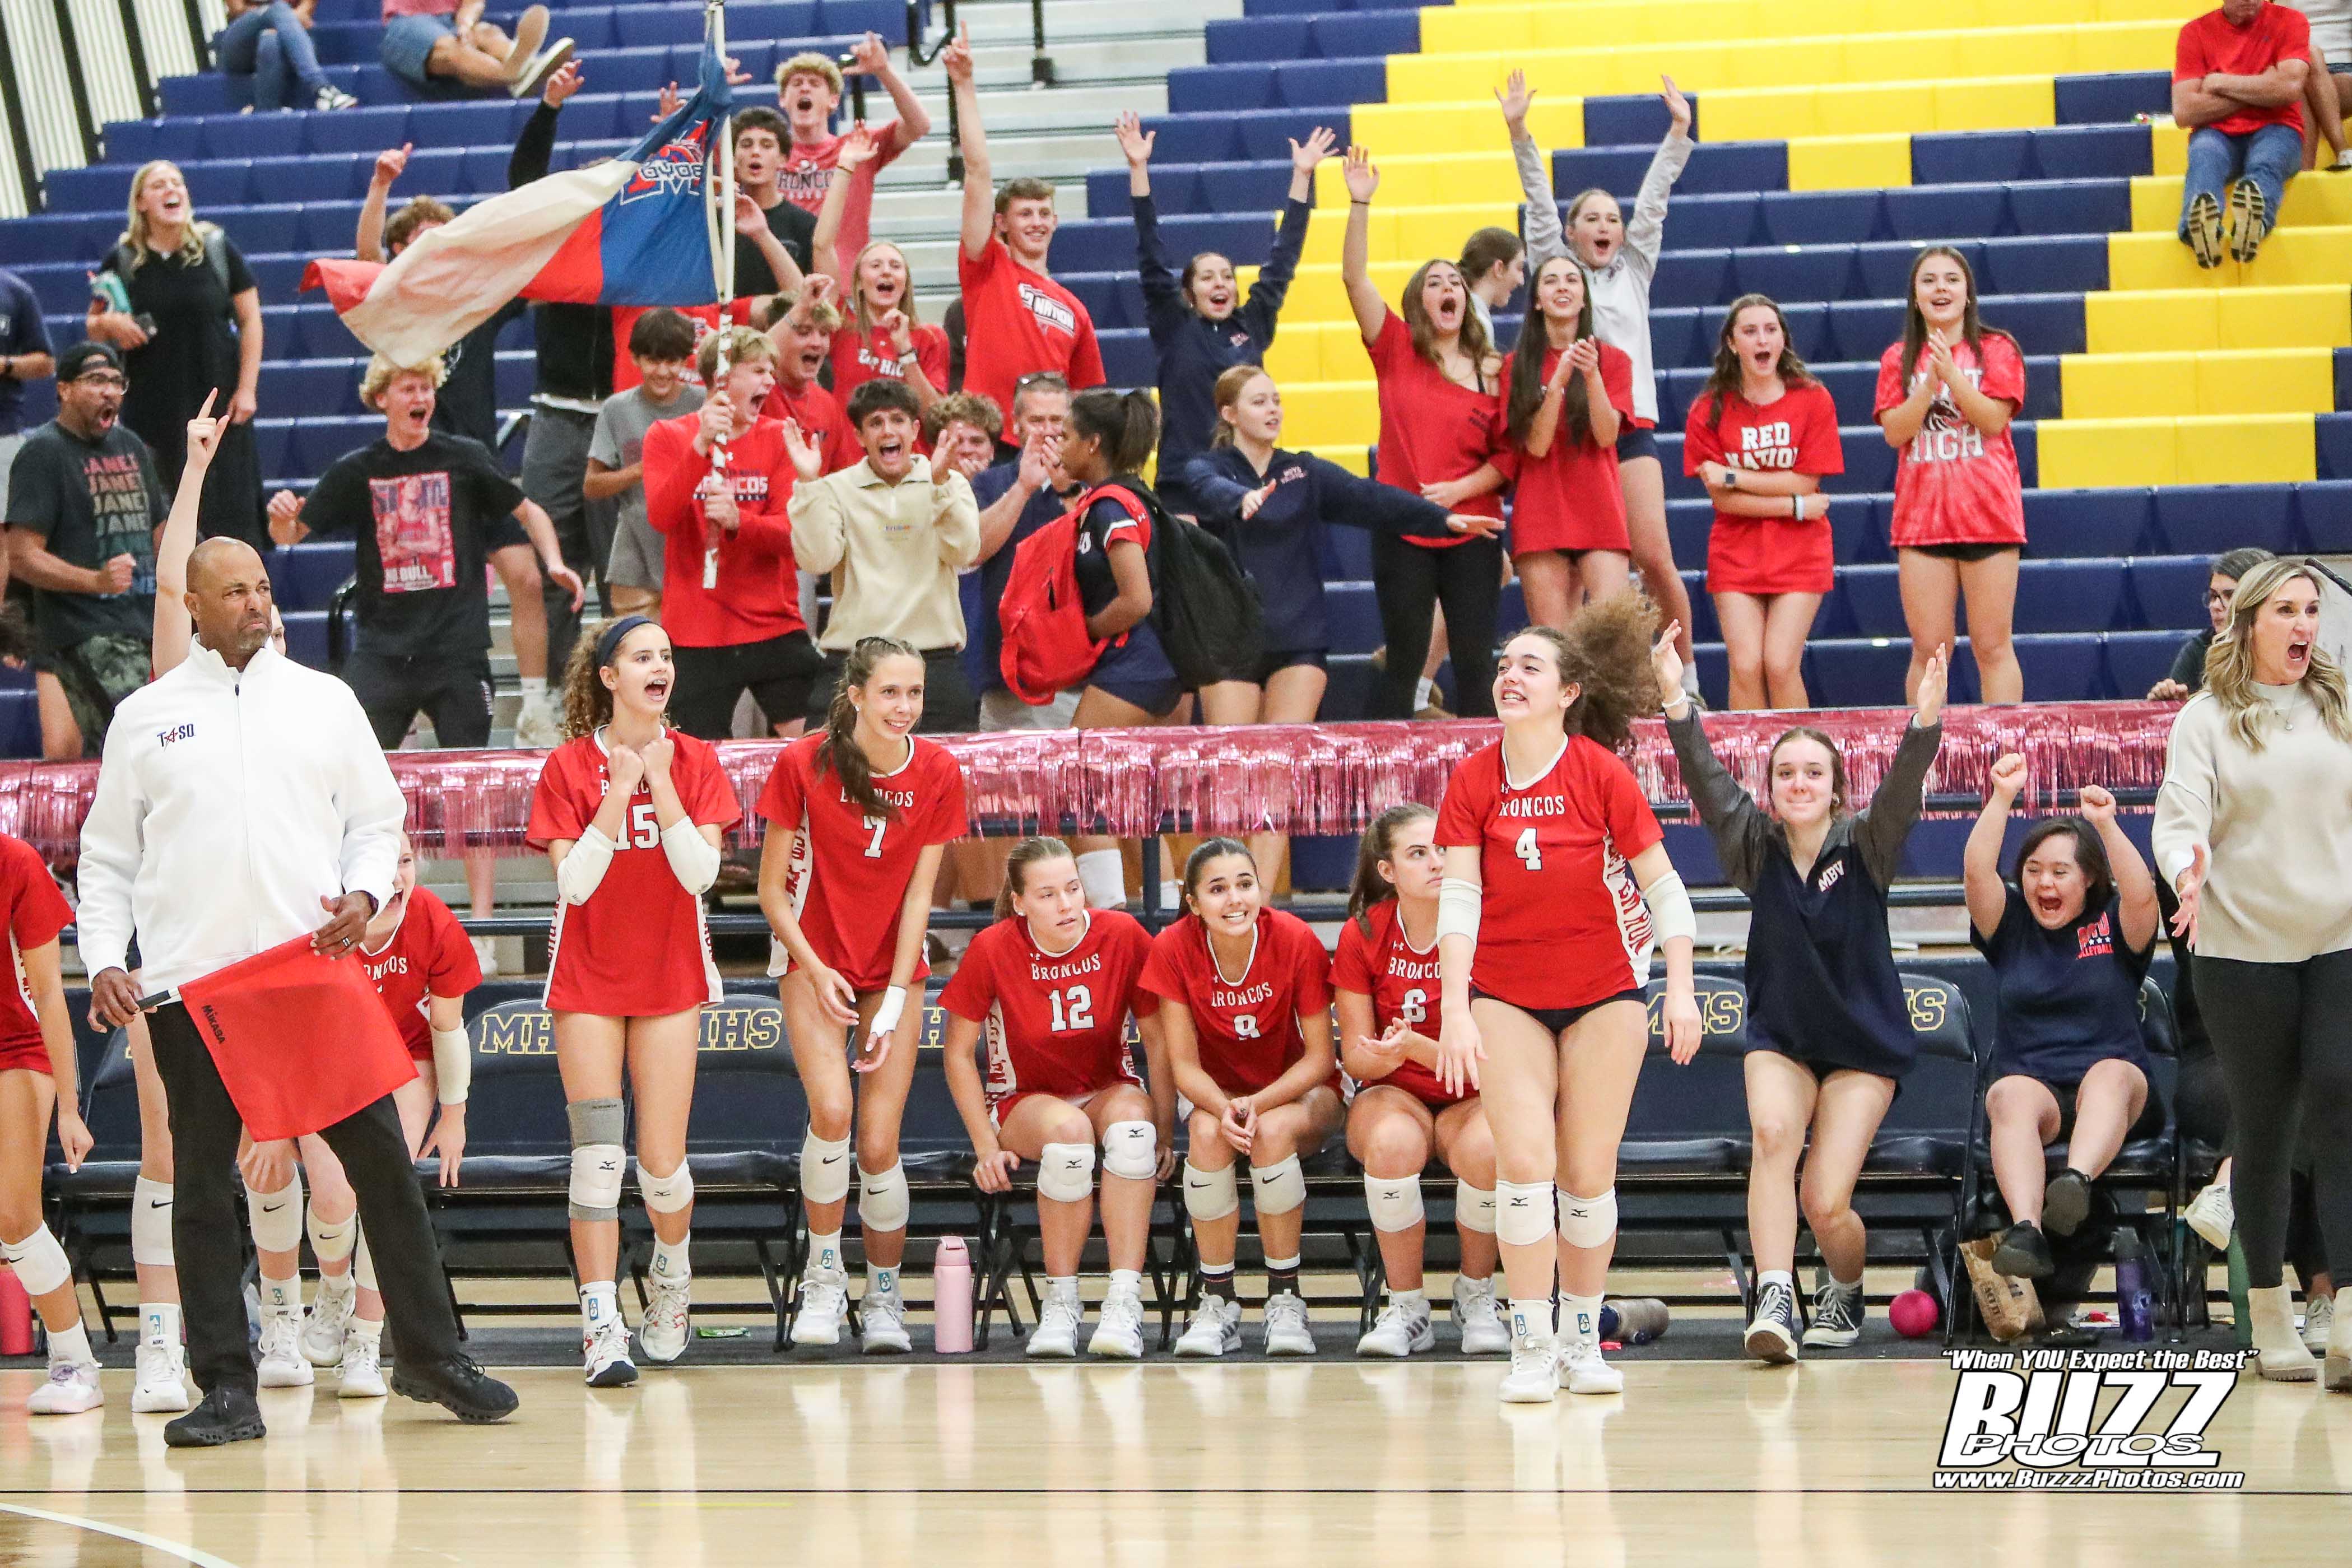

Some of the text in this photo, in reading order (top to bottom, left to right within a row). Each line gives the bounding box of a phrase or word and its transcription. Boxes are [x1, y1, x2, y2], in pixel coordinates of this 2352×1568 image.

[1741, 421, 1791, 450] RED
[615, 803, 660, 850] 15
[1499, 795, 1565, 817] RONCOS
[863, 815, 887, 858] 7
[1515, 827, 1542, 870] 4
[1819, 860, 1844, 892] MBV
[1388, 957, 1442, 979] BRONCO
[1049, 984, 1094, 1032] 12
[479, 1013, 558, 1055] MH
